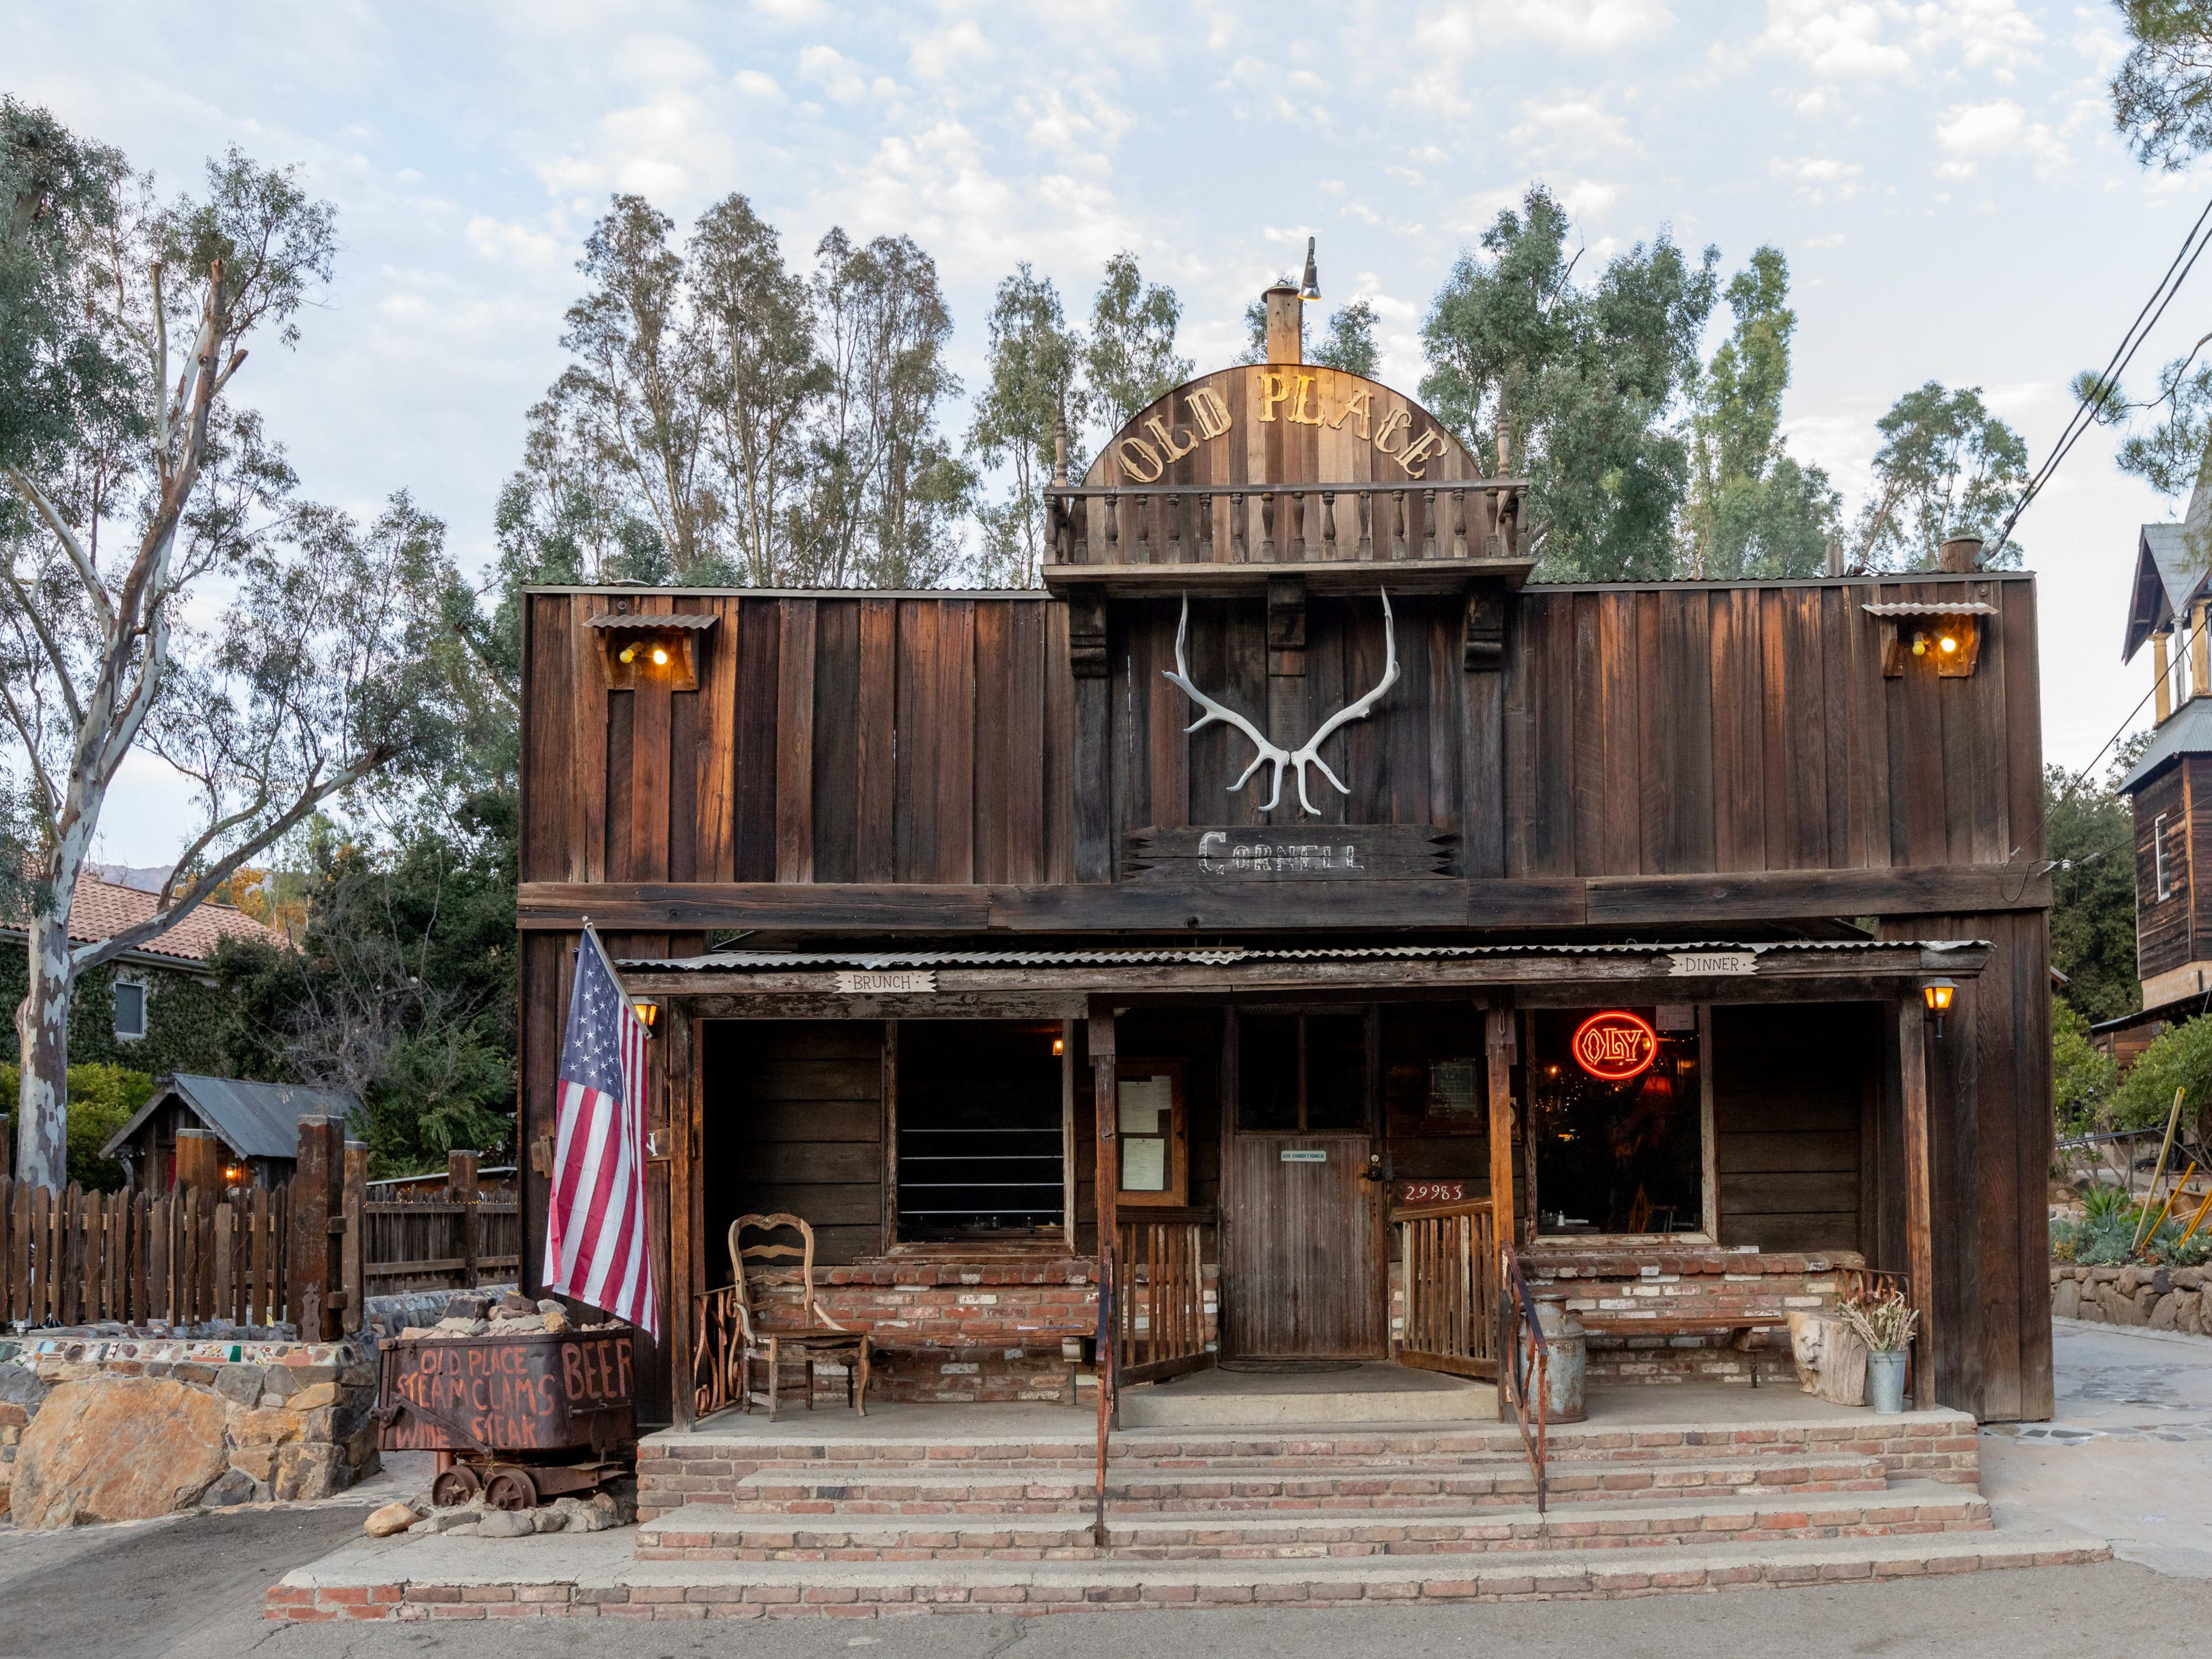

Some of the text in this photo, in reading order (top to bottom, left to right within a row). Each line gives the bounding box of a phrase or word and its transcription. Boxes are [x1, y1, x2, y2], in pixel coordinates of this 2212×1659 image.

[1118, 373, 1448, 483] OLD PLACE
[1198, 831, 1364, 874] CORNELL
[853, 975, 911, 990] BRUNCH
[1685, 957, 1739, 972] DINNER
[1582, 1028, 1643, 1065] OLY
[1406, 1185, 1461, 1200] 29983
[468, 1346, 528, 1376] PLACE
[560, 1338, 634, 1400] BEER
[397, 1371, 555, 1416] STEAM CLAMS
[471, 1412, 537, 1448] STEAK
